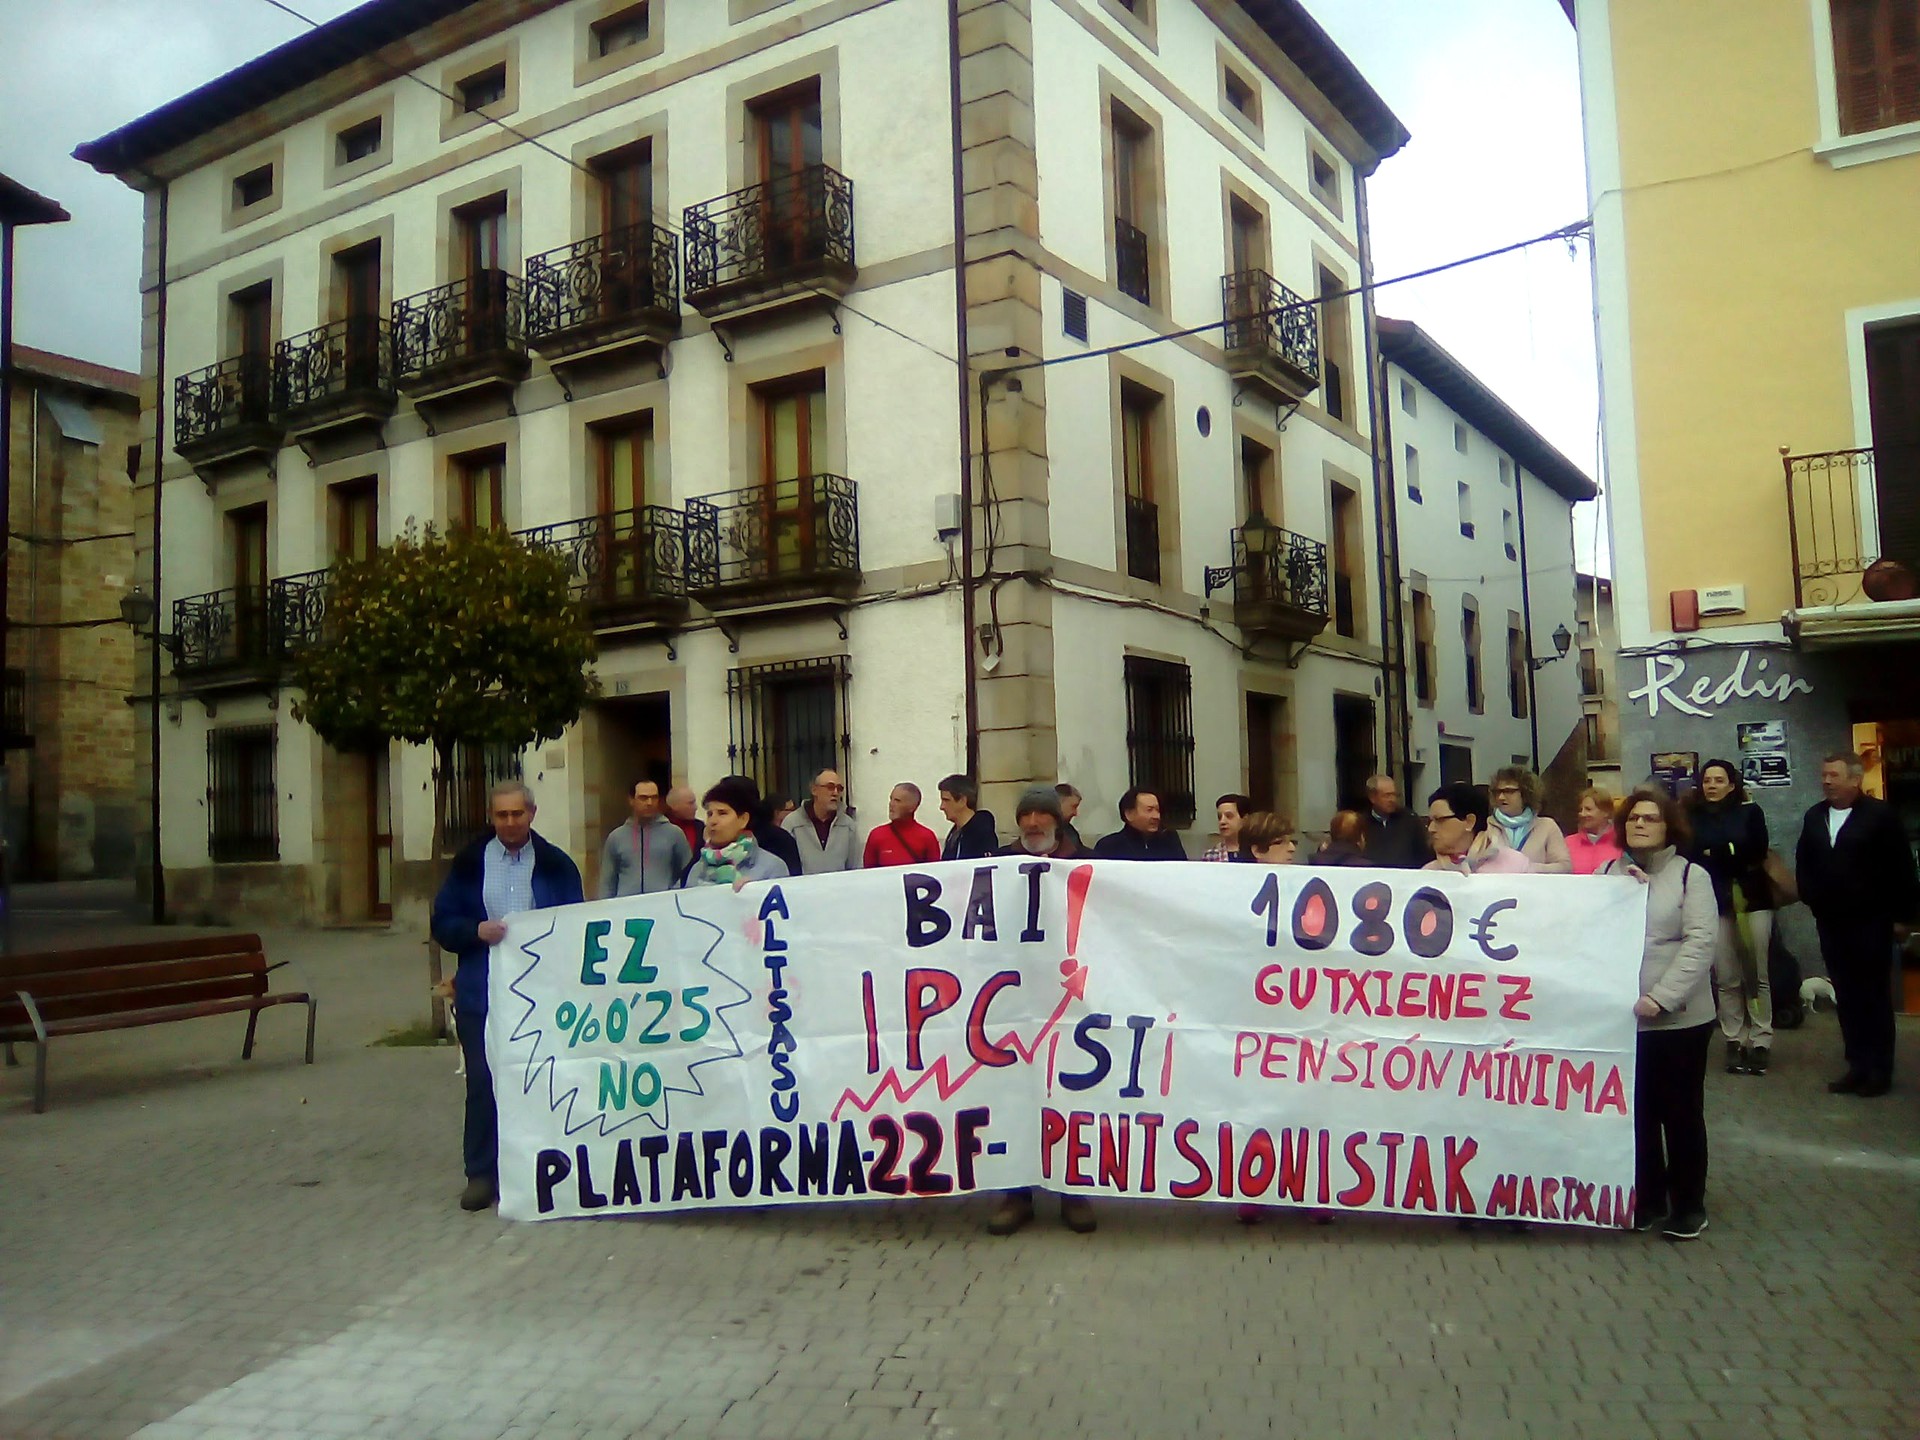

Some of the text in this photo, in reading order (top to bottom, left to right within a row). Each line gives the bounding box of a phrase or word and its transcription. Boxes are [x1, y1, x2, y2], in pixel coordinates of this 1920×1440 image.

[1628, 650, 1814, 718] Redin
[580, 918, 659, 985] EZ
[758, 884, 800, 1124] ALTSASU
[862, 967, 1021, 1074] IPC
[598, 1061, 662, 1112] NO
[1234, 1032, 1628, 1116] PENSIÓN MÍNIMA
[1040, 1106, 1479, 1215] PENTSIONISTAK
[1485, 1173, 1637, 1230] MARTXAN
